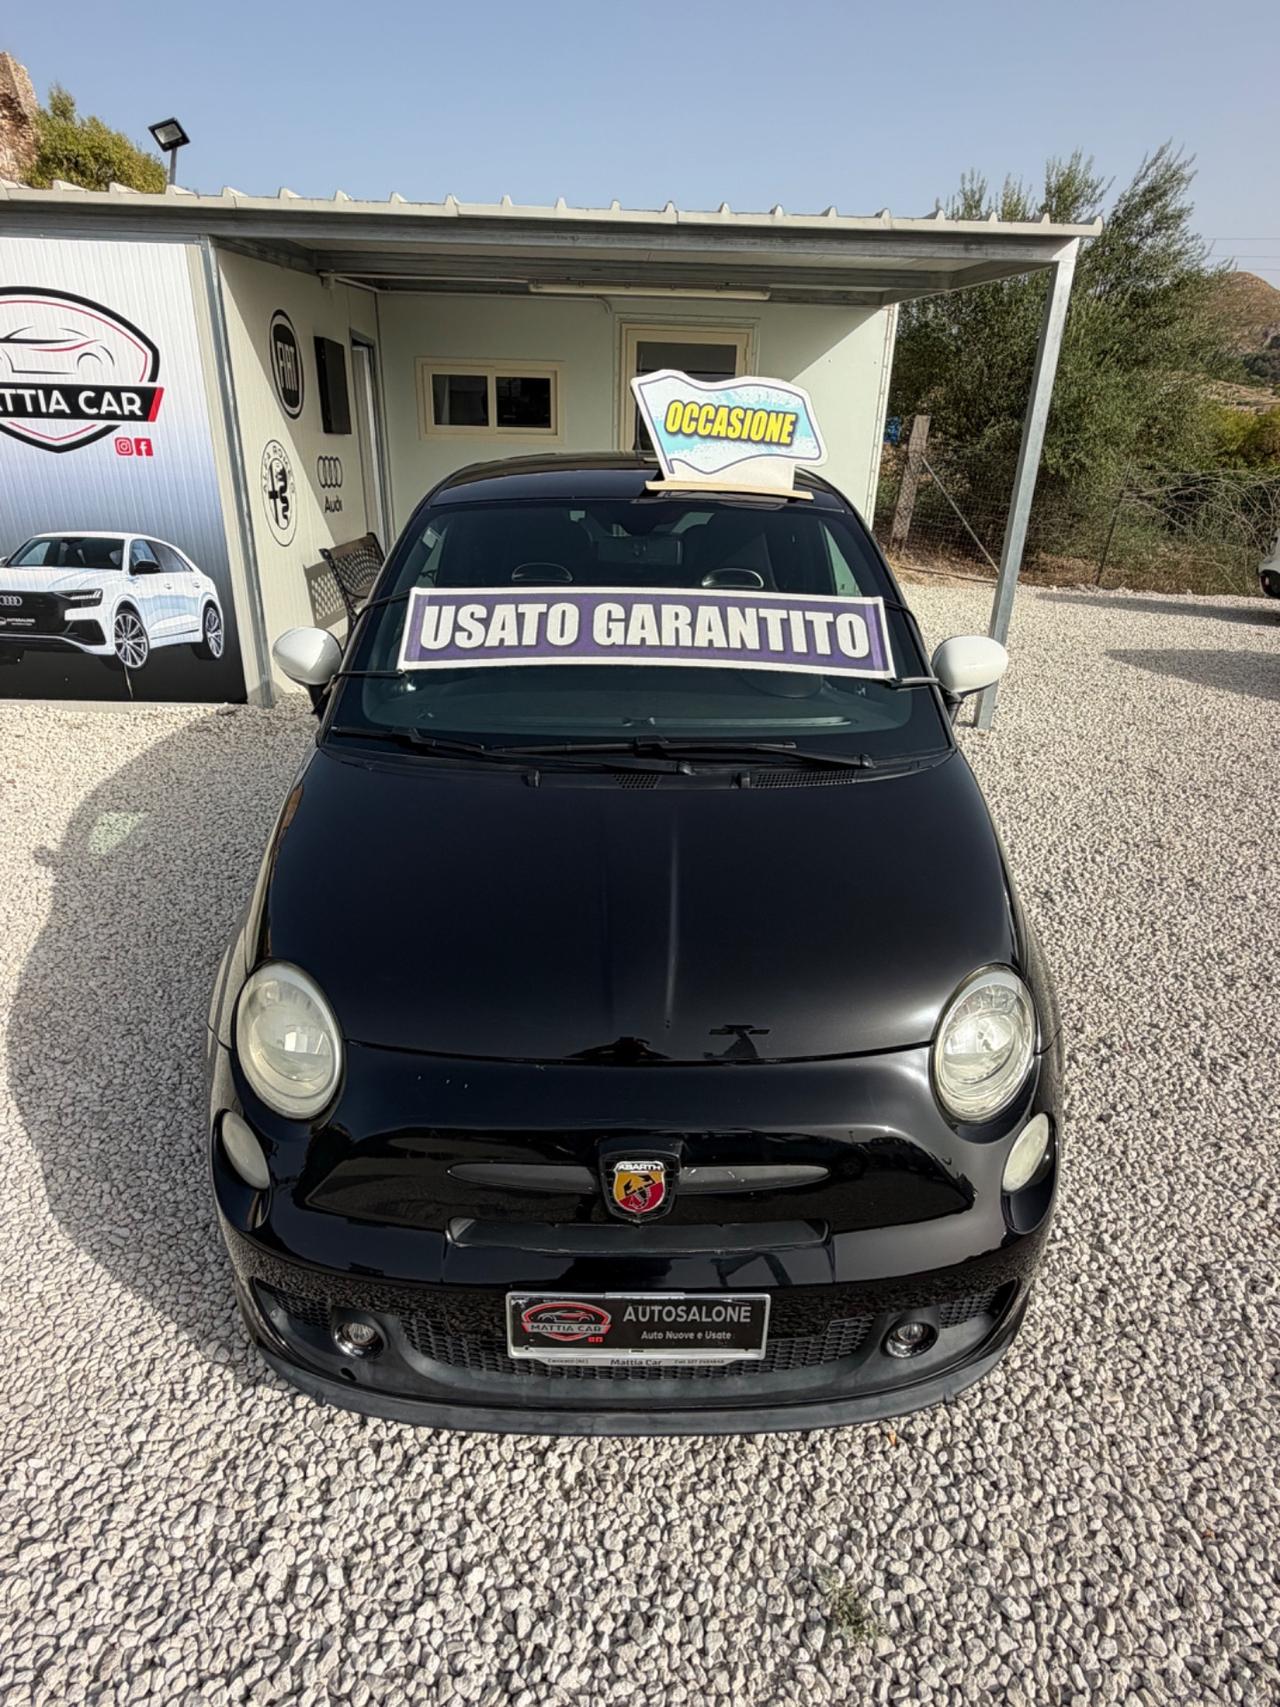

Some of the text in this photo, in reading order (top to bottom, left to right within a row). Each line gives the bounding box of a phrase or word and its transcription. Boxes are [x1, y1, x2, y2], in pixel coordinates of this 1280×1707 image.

[276, 340, 298, 392] FIAT
[0, 388, 143, 416] TTIA CAR
[664, 399, 797, 446] OCCASIONE
[325, 494, 343, 513] Audi
[419, 602, 870, 658] USATO GARANTITO
[623, 1305, 752, 1322] AUTOSALONE
[530, 1324, 602, 1333] MATTIA CAR
[641, 1330, 664, 1340] Auto
[665, 1330, 694, 1340] Nuove
[705, 1330, 732, 1340] Usate
[609, 1359, 662, 1367] Mattia Car
